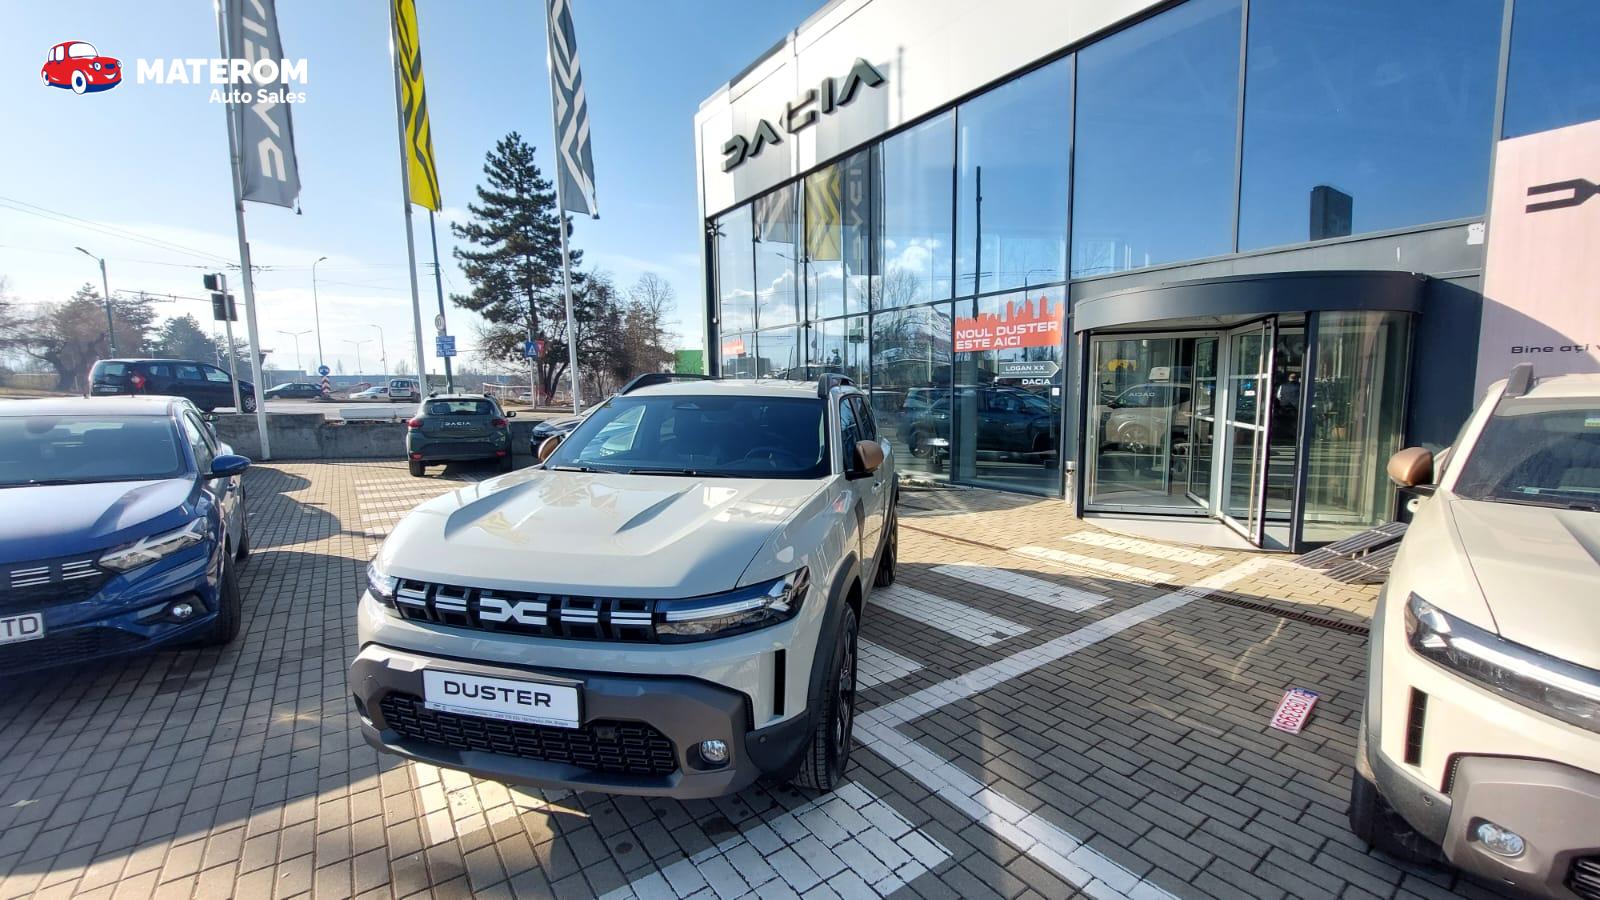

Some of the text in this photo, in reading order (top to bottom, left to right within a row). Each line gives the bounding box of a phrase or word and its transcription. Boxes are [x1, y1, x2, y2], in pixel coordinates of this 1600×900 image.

[721, 57, 886, 172] DACIA
[956, 321, 1058, 339] NOUL DUSTER
[956, 336, 1020, 350] ESTE AICI
[1511, 346, 1554, 354] Bine
[443, 680, 551, 708] DUSTER
